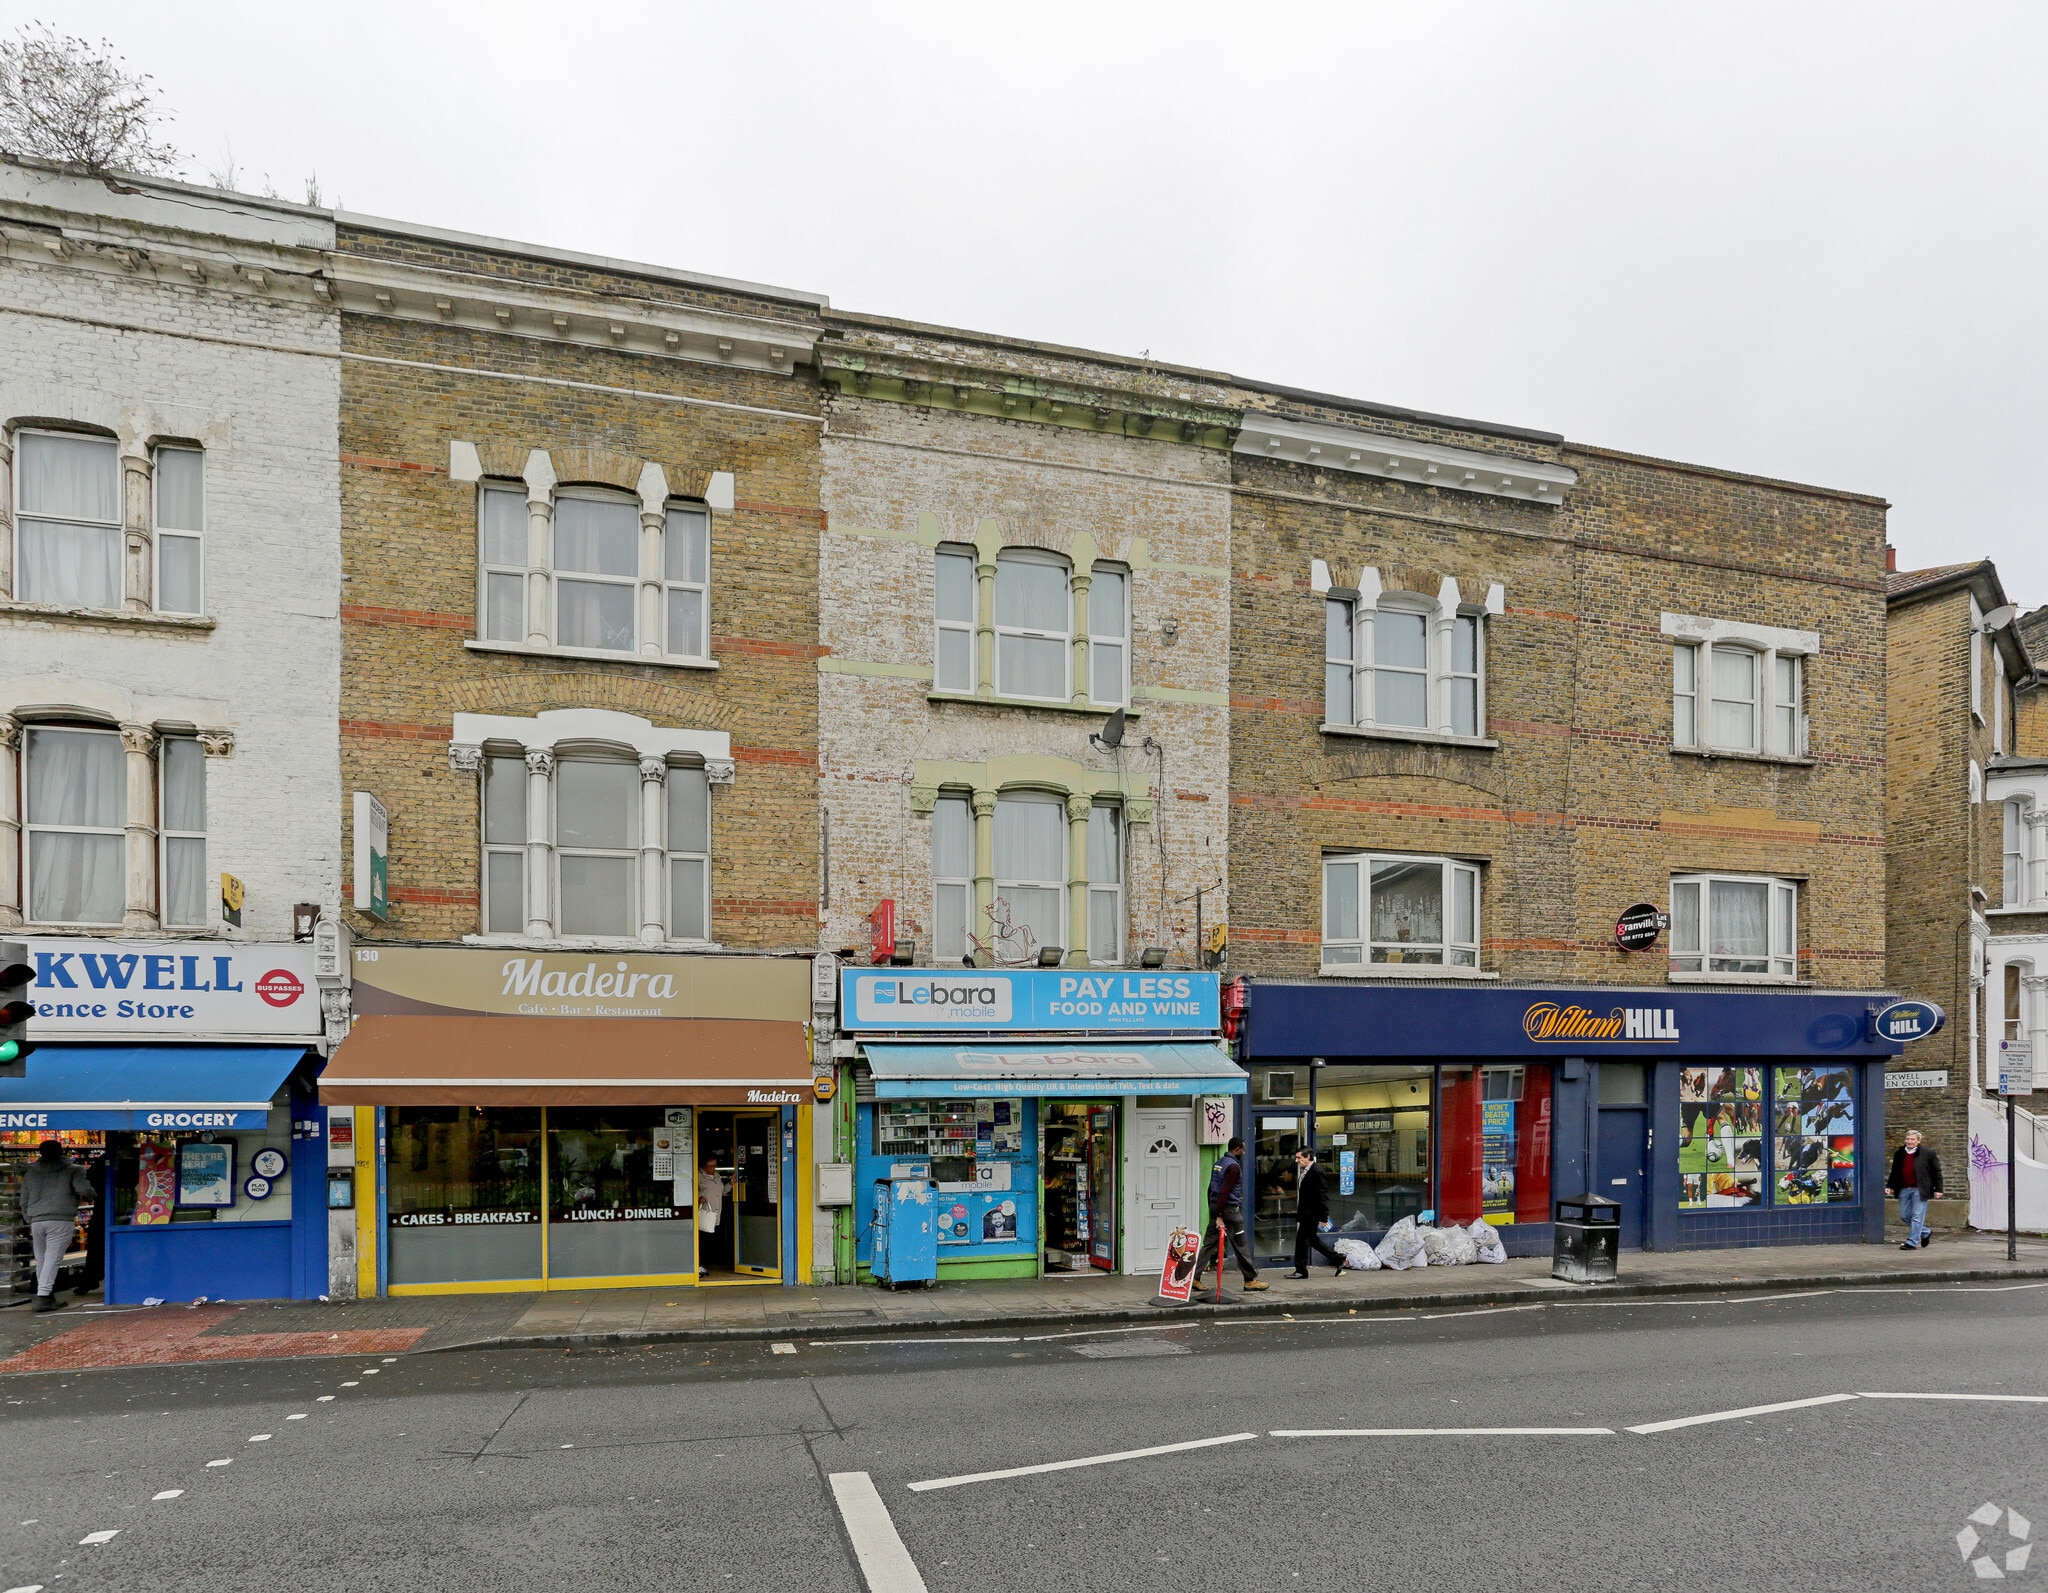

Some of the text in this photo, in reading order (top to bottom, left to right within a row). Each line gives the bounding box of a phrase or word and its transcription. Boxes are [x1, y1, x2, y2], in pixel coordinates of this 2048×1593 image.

[1657, 920, 1667, 929] By
[355, 950, 379, 962] 130
[34, 952, 243, 993] KWELL
[502, 958, 678, 999] Madeira
[273, 985, 303, 993] PASSES
[899, 981, 996, 1006] Lebara
[1060, 978, 1191, 999] PAY LESS
[117, 1000, 195, 1019] Store
[518, 1003, 662, 1016] Café Bar Restaurant
[950, 1006, 996, 1018] mobile
[1050, 1002, 1201, 1016] FOOD AND WINE
[1890, 1008, 1920, 1020] William
[1523, 1002, 1679, 1040] William HILL
[1890, 1019, 1921, 1035] HILL
[998, 1055, 1140, 1066] Lebara
[1885, 1073, 1920, 1081] CKWELL
[1901, 1079, 1933, 1087] COURT
[953, 1083, 994, 1093] Low-Cost,
[995, 1082, 1014, 1093] High
[1015, 1083, 1045, 1093] Quality
[1046, 1083, 1058, 1091] UK
[1059, 1083, 1065, 1091] &
[1067, 1082, 1118, 1091] International
[1137, 1082, 1154, 1090] Text
[1155, 1082, 1162, 1090] &
[1163, 1082, 1180, 1090] data
[747, 1089, 802, 1103] Madeira
[1488, 1103, 1509, 1111] WON'T
[147, 1113, 239, 1127] GROCERY
[1487, 1118, 1507, 1126] PRICE
[182, 1152, 224, 1161] THEY'RE
[976, 1167, 993, 1180] ra
[400, 1208, 673, 1226] CAKES BREAKFAST LUNCH DINNER
